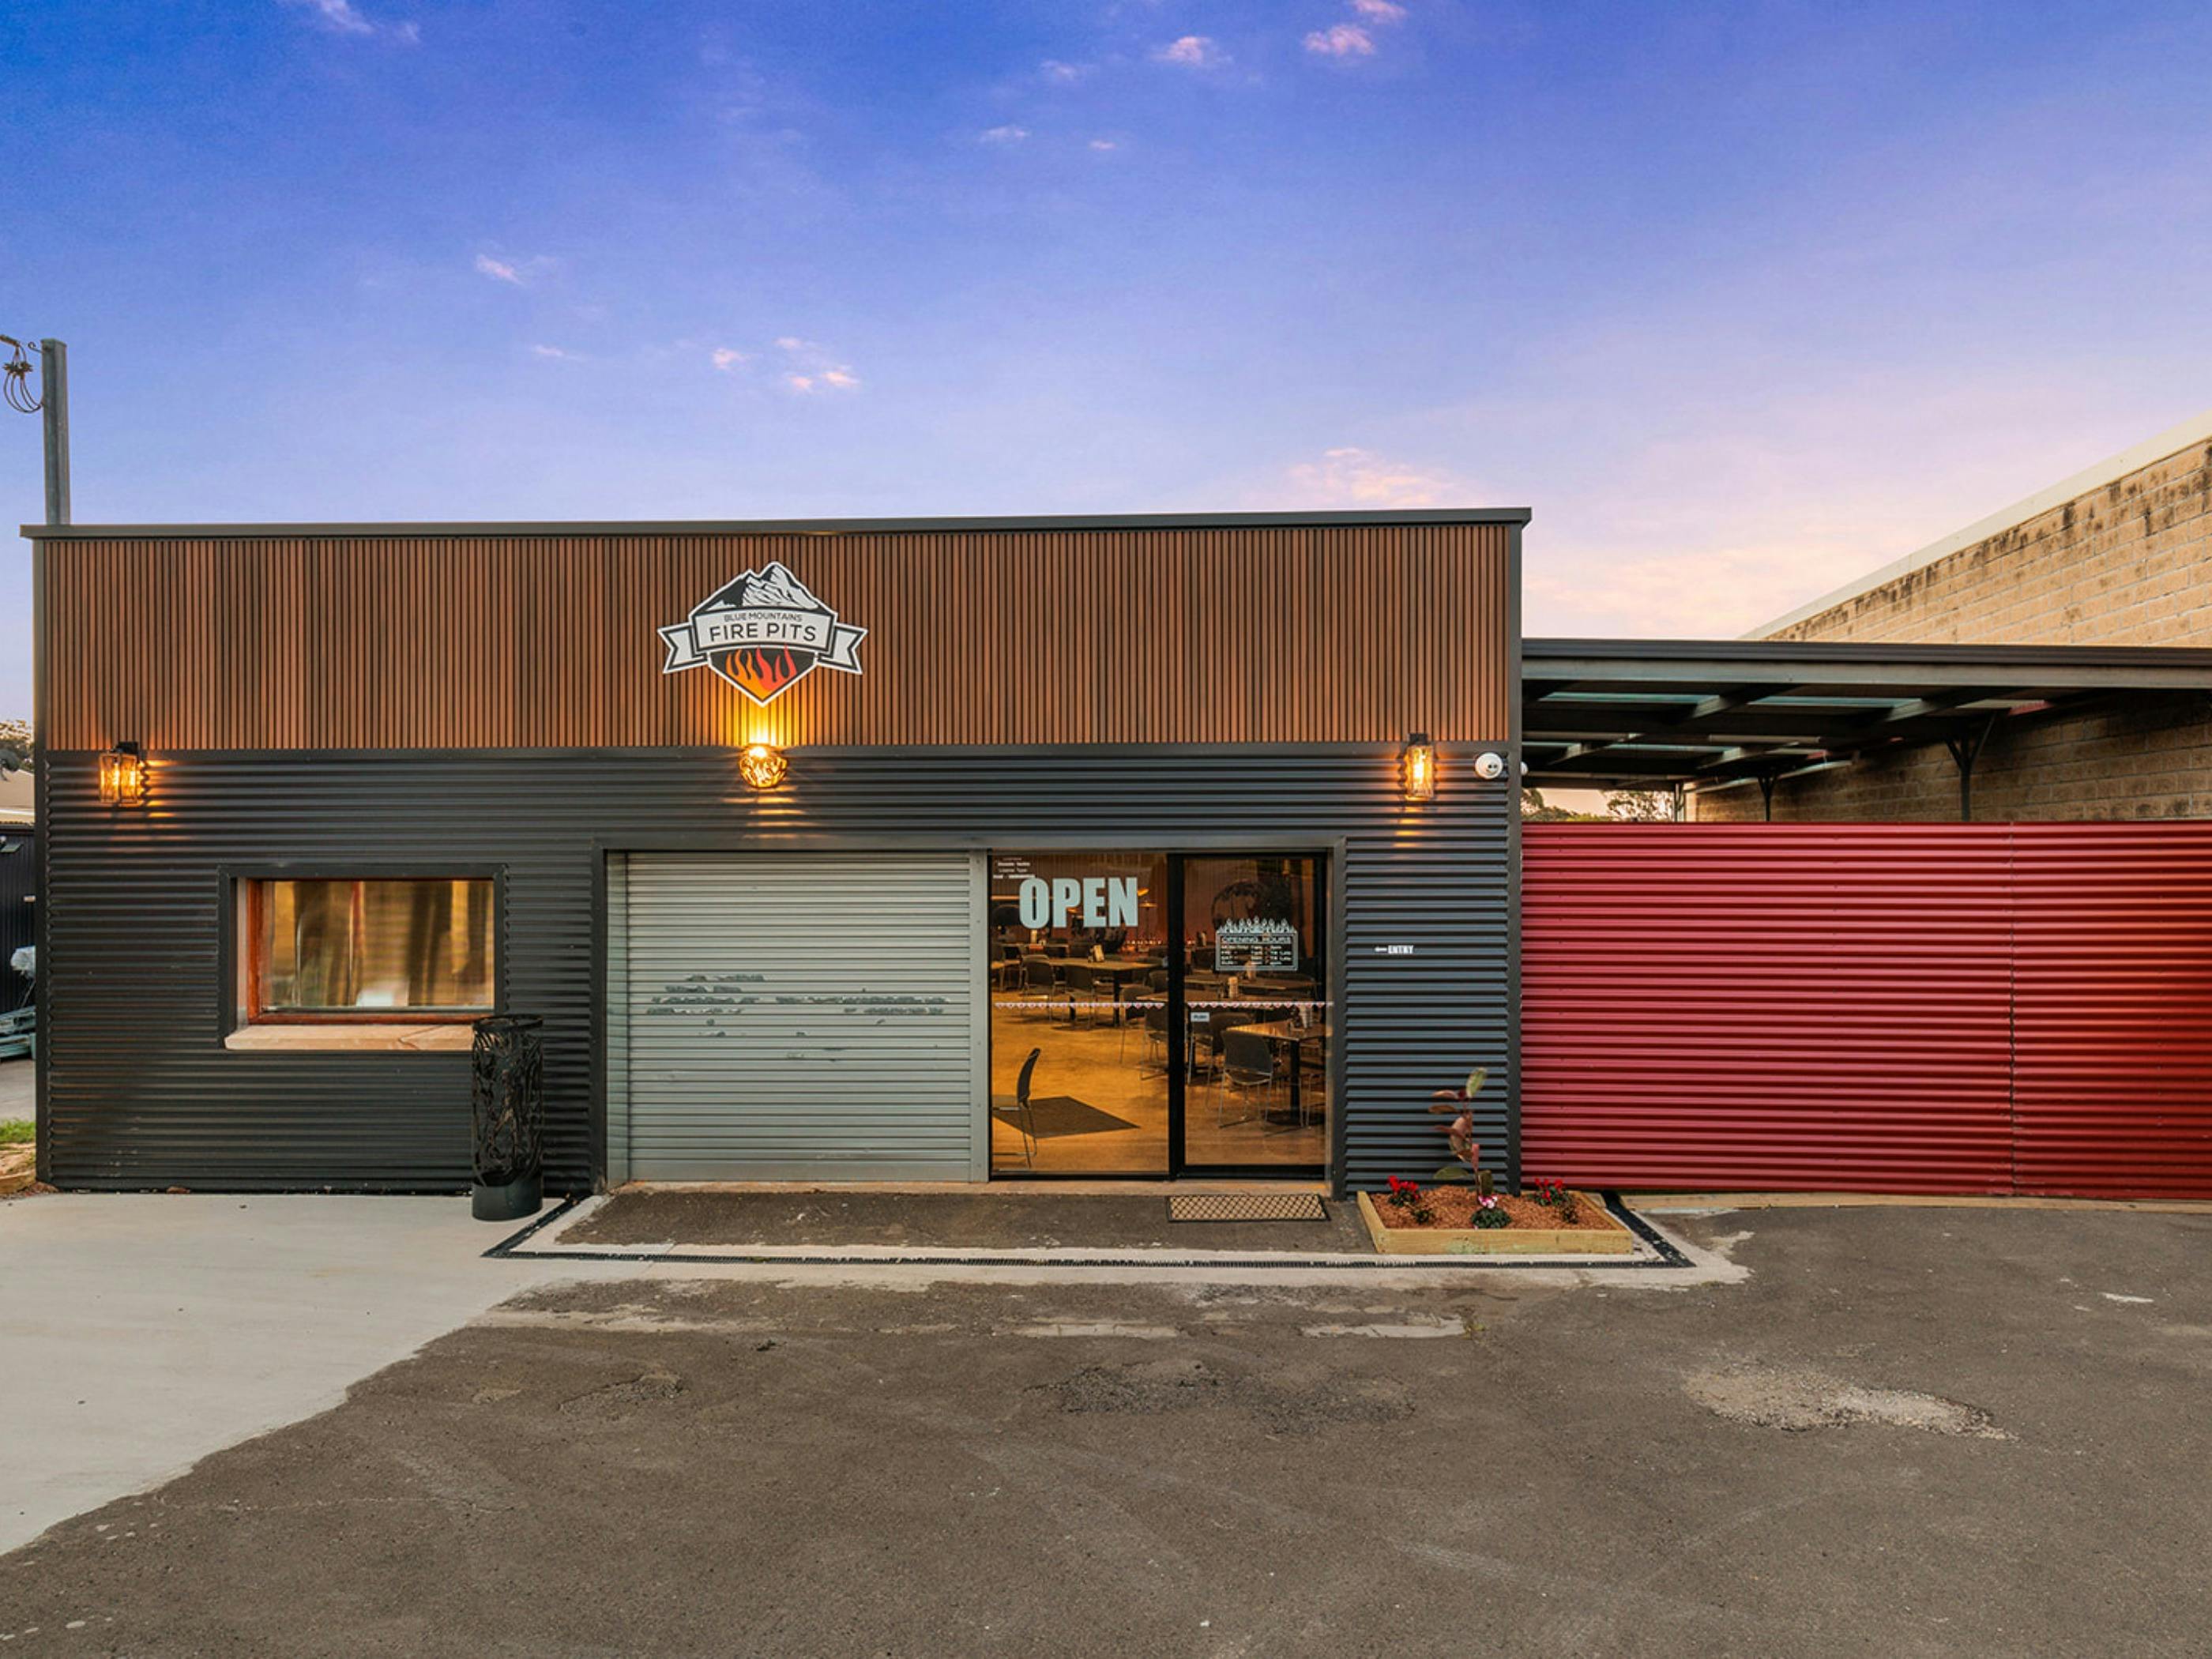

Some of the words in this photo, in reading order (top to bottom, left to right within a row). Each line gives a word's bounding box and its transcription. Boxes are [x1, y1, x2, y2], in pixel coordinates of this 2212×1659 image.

[724, 613, 747, 623] BLUE
[749, 611, 803, 623] MOUNTAINS
[709, 623, 758, 642] FIRE
[766, 623, 817, 641] PITS
[1019, 877, 1139, 929] OPEN
